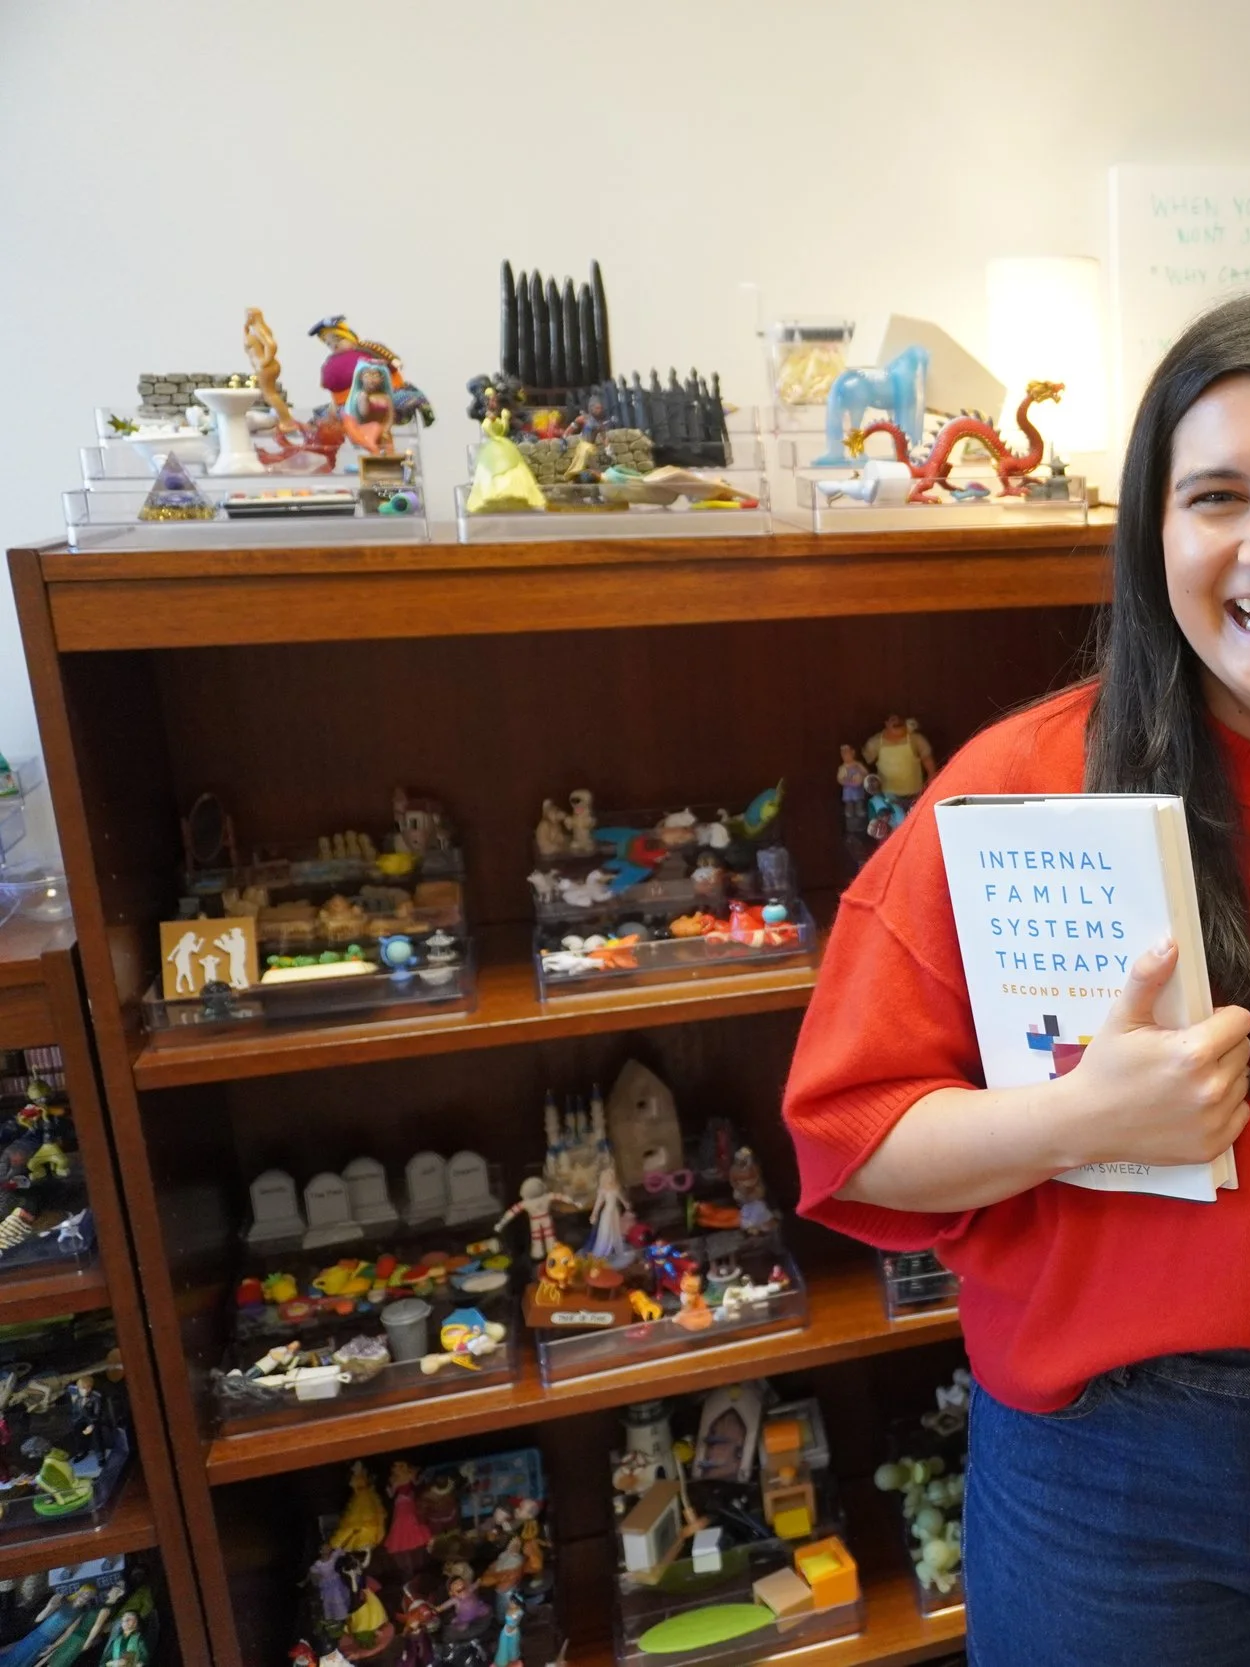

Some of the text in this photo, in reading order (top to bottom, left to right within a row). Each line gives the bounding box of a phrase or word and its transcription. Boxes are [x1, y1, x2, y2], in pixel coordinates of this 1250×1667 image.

[1151, 193, 1219, 219] WHEN
[979, 849, 1113, 872] INTERNAL
[985, 884, 1117, 906] FAMILY
[991, 917, 1126, 940] SYSTEMS
[996, 950, 1130, 975] THERAPY
[1002, 983, 1123, 999] SECOND EDITIO
[1099, 1162, 1151, 1176] SWEEZY
